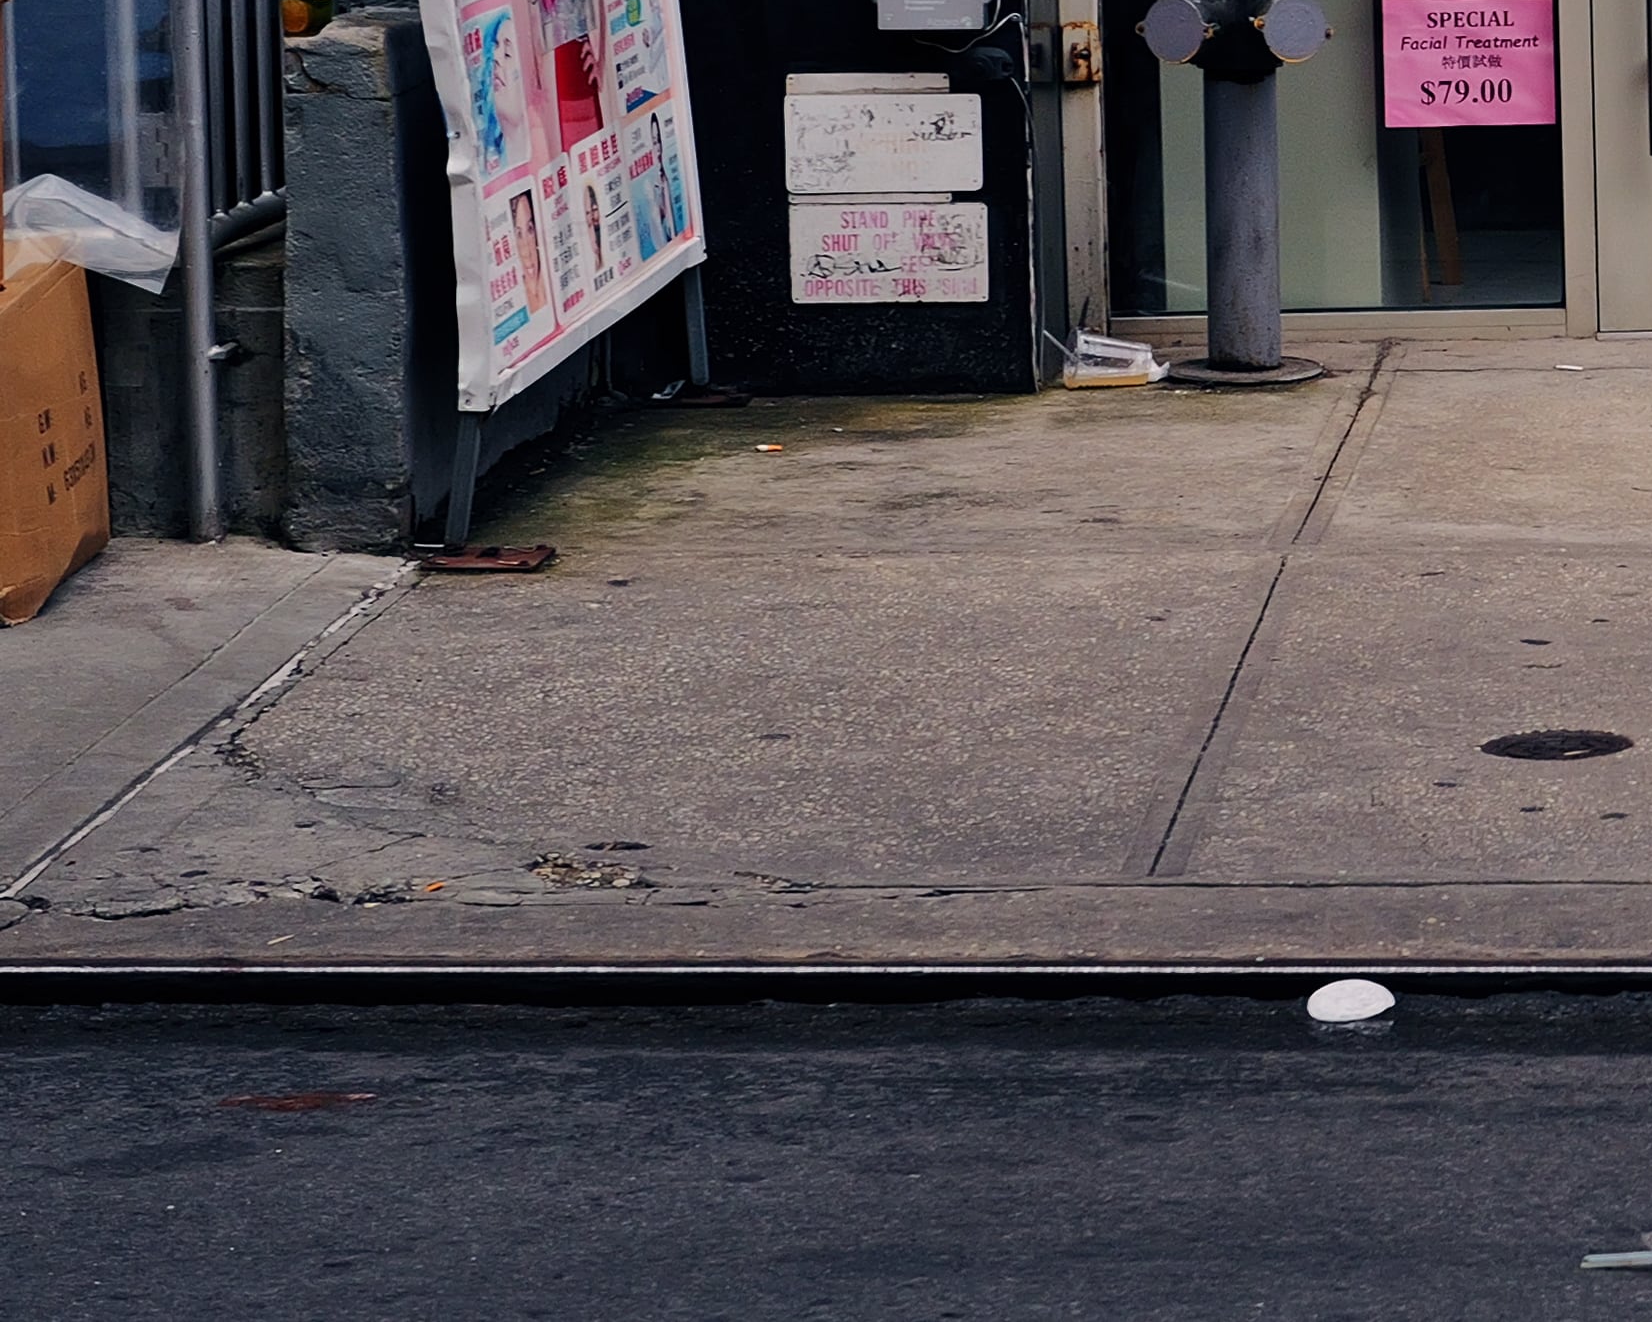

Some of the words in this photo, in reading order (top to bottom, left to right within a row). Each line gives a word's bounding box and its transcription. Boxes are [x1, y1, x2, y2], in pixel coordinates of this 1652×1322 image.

[1426, 11, 1515, 29] SPECIAL
[1400, 36, 1447, 51] Facial
[1454, 34, 1540, 49] Treatment
[1419, 78, 1513, 105] $79.00
[840, 211, 889, 230] STAND
[821, 233, 861, 253] SHUT
